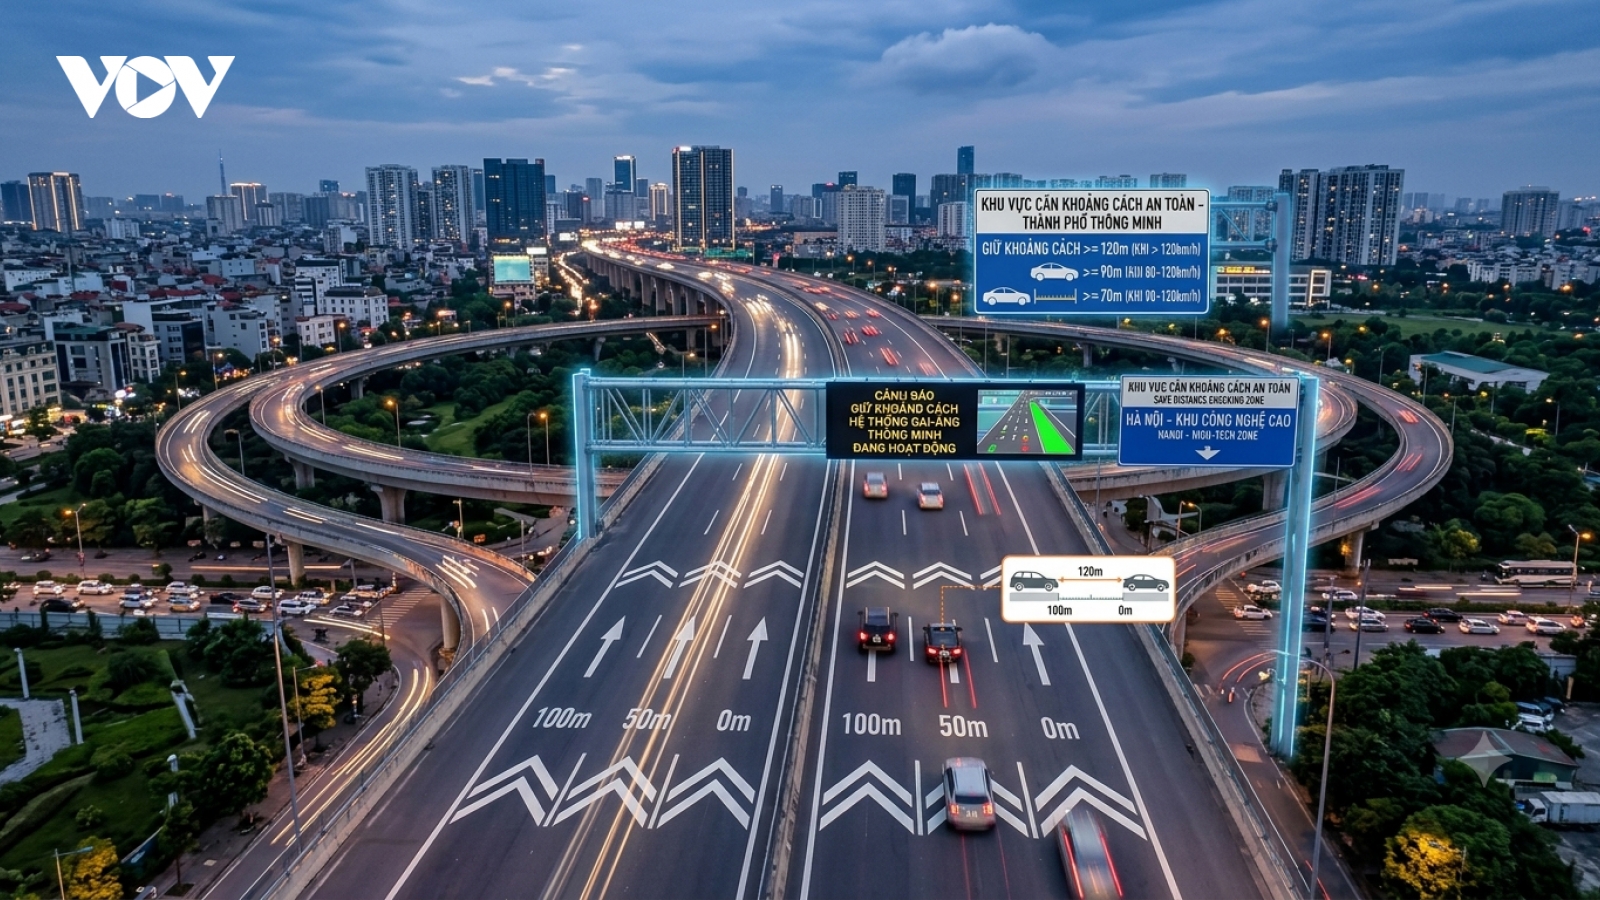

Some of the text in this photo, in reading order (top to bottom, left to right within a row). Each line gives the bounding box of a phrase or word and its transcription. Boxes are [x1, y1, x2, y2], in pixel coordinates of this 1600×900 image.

[981, 197, 1004, 211] KHU
[1008, 197, 1032, 213] VỰC
[1113, 194, 1142, 211] CÁCH
[1146, 197, 1162, 211] AN
[1132, 216, 1162, 230] MINH
[1100, 242, 1128, 255] 120m
[1100, 265, 1122, 278] 90m
[1100, 288, 1122, 302] 70m
[1128, 382, 1146, 392] KHU
[1252, 382, 1265, 394] AN
[1246, 396, 1264, 404] ZONE
[1176, 413, 1198, 426] KHU
[1268, 414, 1291, 428] CAO
[911, 430, 942, 440] MINH
[1236, 430, 1258, 440] ZONE
[532, 706, 592, 729] 100m
[622, 708, 672, 730] 50m
[716, 709, 751, 731] 0m
[842, 712, 902, 735] 100m
[939, 714, 989, 738] 50m
[1040, 716, 1080, 740] 0m
